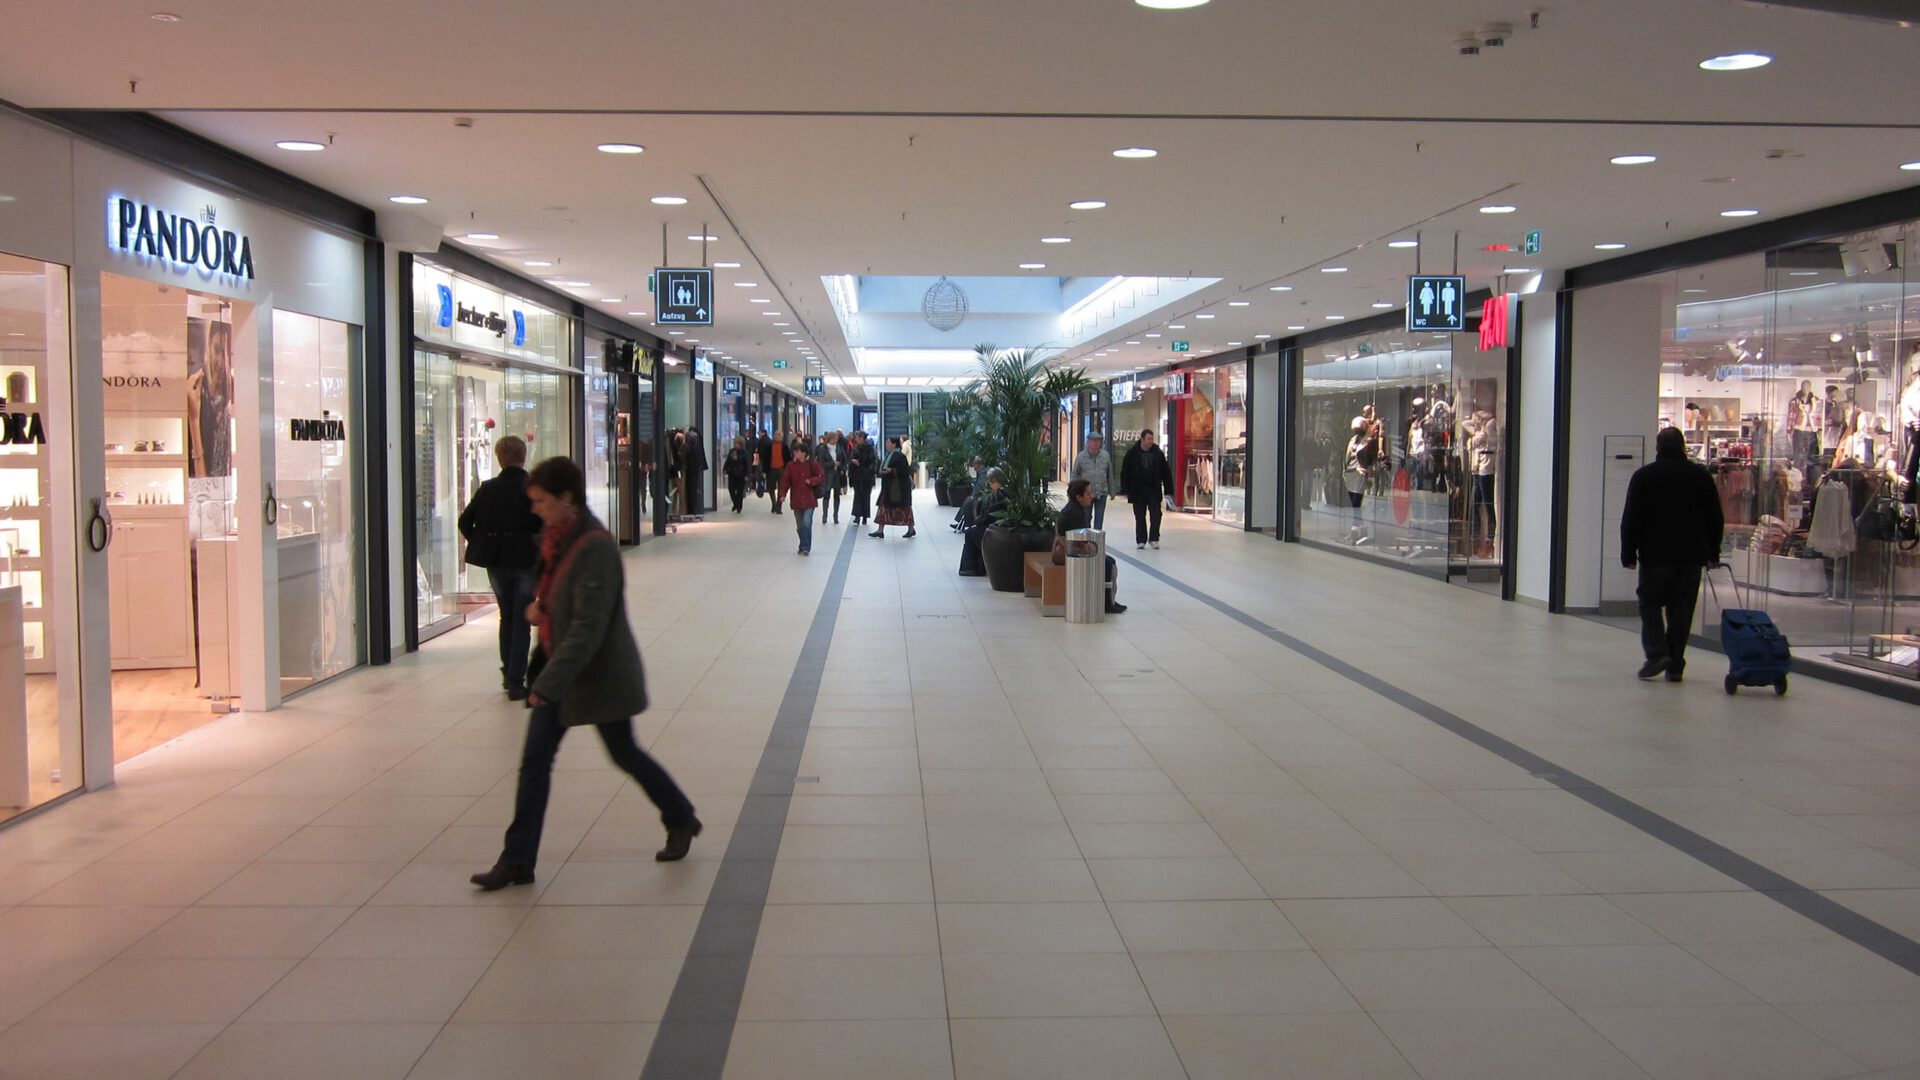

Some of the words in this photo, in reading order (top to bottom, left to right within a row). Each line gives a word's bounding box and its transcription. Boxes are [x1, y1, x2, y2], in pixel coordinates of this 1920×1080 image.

[118, 198, 255, 280] PANDORA
[661, 312, 686, 321] Aufzug
[1415, 318, 1427, 326] WC
[290, 418, 346, 441] PANDORA
[1112, 429, 1141, 442] STIEFE
